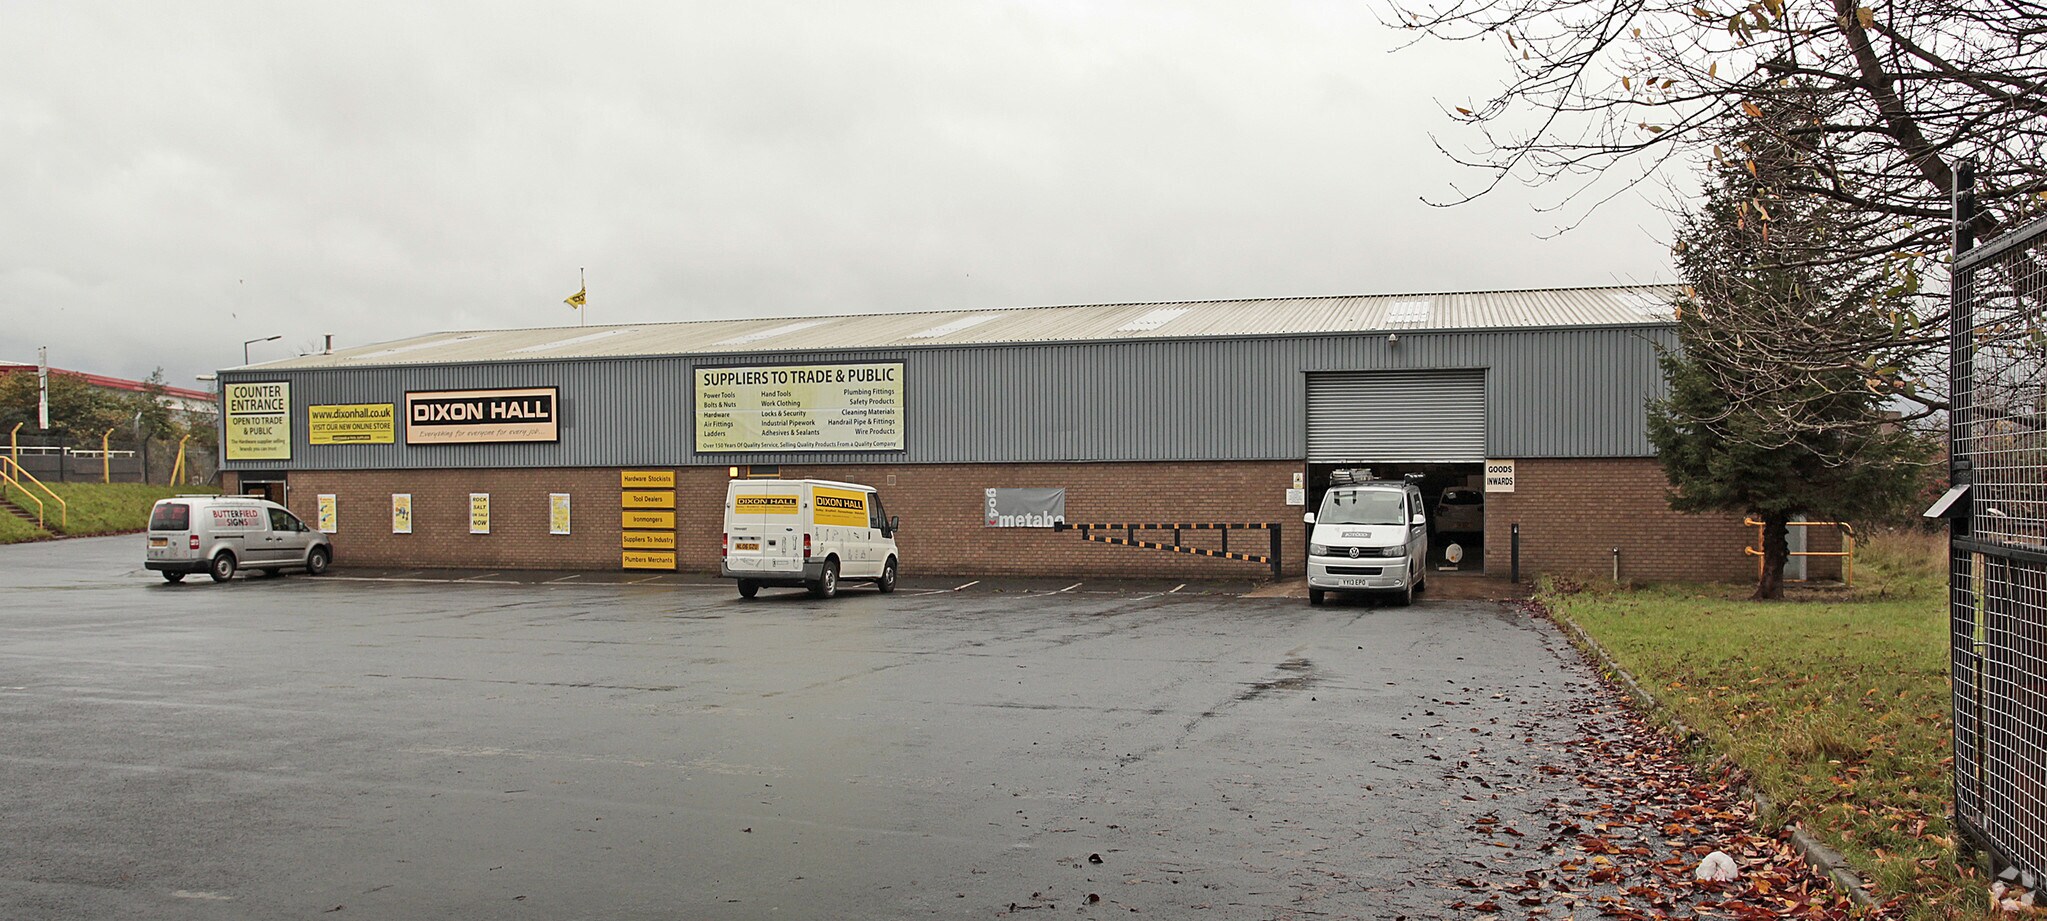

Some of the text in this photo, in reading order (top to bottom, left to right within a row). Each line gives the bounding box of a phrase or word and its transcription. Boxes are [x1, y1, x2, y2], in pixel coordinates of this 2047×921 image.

[704, 368, 894, 386] SUPPLIERS TO TRADE & PUBLIC
[234, 386, 281, 398] COUNTER
[232, 398, 284, 411] ENTRANCE
[312, 408, 390, 418] www.dixonhall.co.uk
[414, 401, 548, 421] DIXON HALL
[243, 427, 248, 435] &
[420, 431, 453, 439] Everything
[816, 497, 862, 508] DIXON HALL
